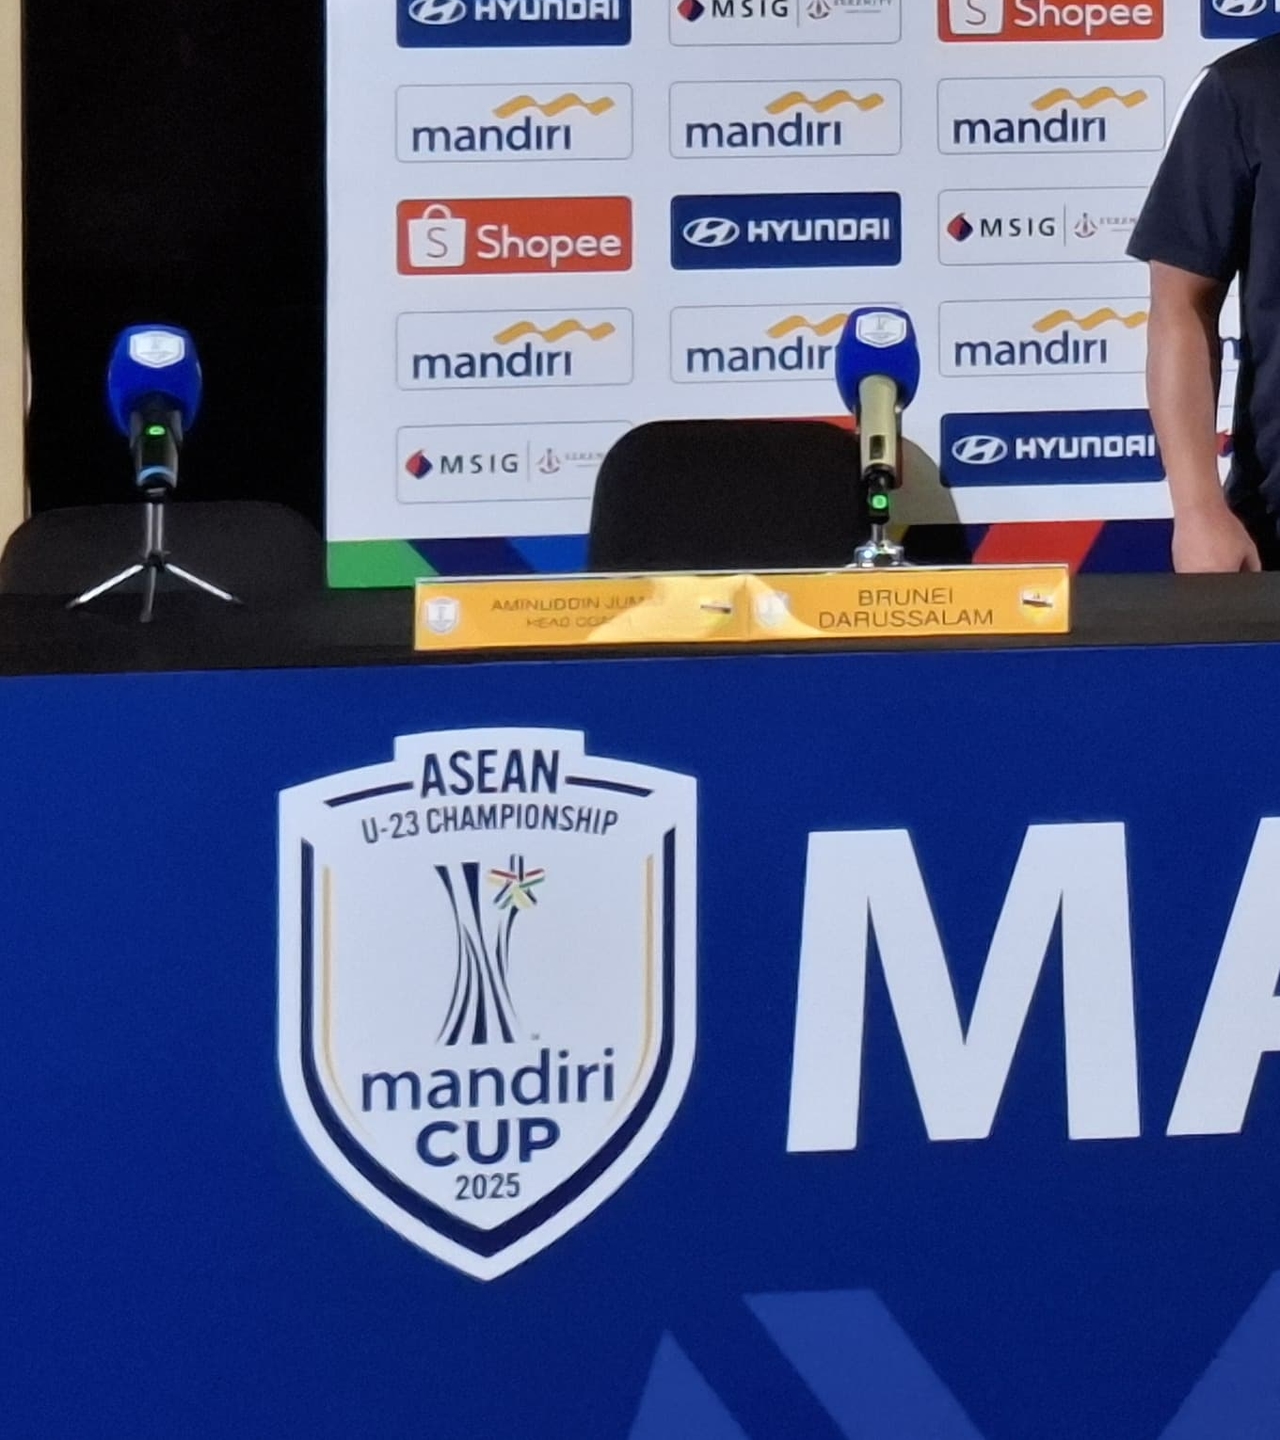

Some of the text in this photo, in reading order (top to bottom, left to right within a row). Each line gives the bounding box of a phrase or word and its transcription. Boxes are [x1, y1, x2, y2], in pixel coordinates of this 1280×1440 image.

[413, 116, 570, 152] mandiri
[687, 113, 841, 147] mandiri
[954, 109, 1105, 143] mandiri
[748, 218, 889, 242] HYUNDAI
[981, 218, 1054, 237] MSIG
[477, 225, 621, 268] Shopee
[414, 342, 571, 378] mandiri
[687, 336, 833, 373] mandir
[955, 331, 1106, 366] mandiri
[441, 454, 517, 473] MSIG
[1016, 435, 1155, 459] HYUNDAI
[859, 588, 952, 606] BRUNEI
[819, 609, 992, 628] DARUSSALAM
[421, 749, 559, 798] ASEAN
[362, 804, 618, 843] U-23 CHAMPIONSHIP
[362, 1048, 613, 1111] mandiri
[416, 1117, 560, 1167] CUP
[456, 1173, 519, 1200] 2025
